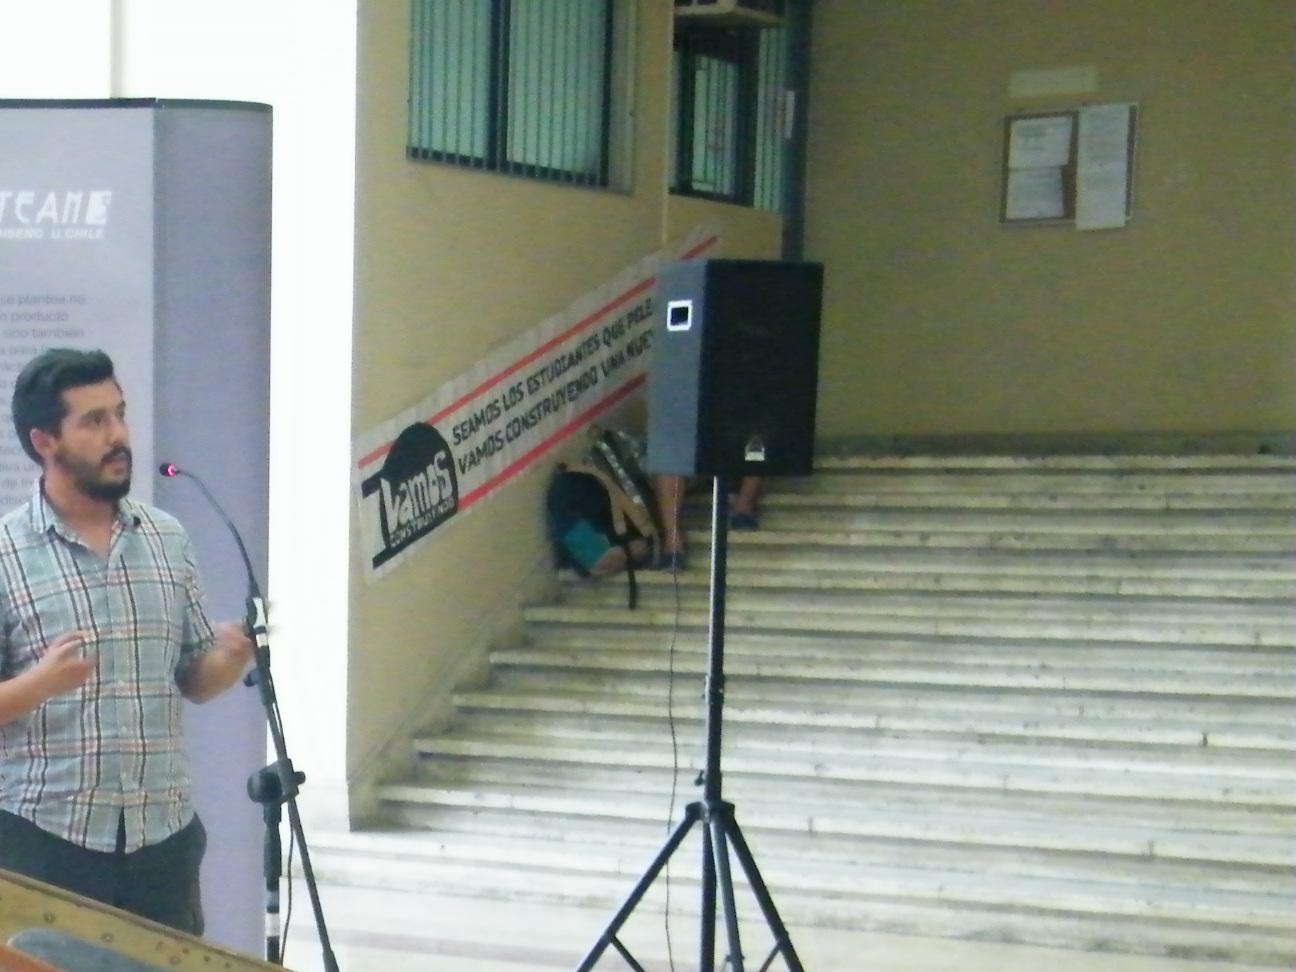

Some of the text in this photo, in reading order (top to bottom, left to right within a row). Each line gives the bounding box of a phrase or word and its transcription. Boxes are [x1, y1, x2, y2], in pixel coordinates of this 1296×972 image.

[451, 402, 502, 446] SEAMOS
[502, 382, 524, 413] LOS
[526, 331, 601, 397] ESTUDIANTES
[602, 320, 626, 347] QUE
[457, 331, 655, 475] VAMOS CONSTRUYENDO UNA NUE
